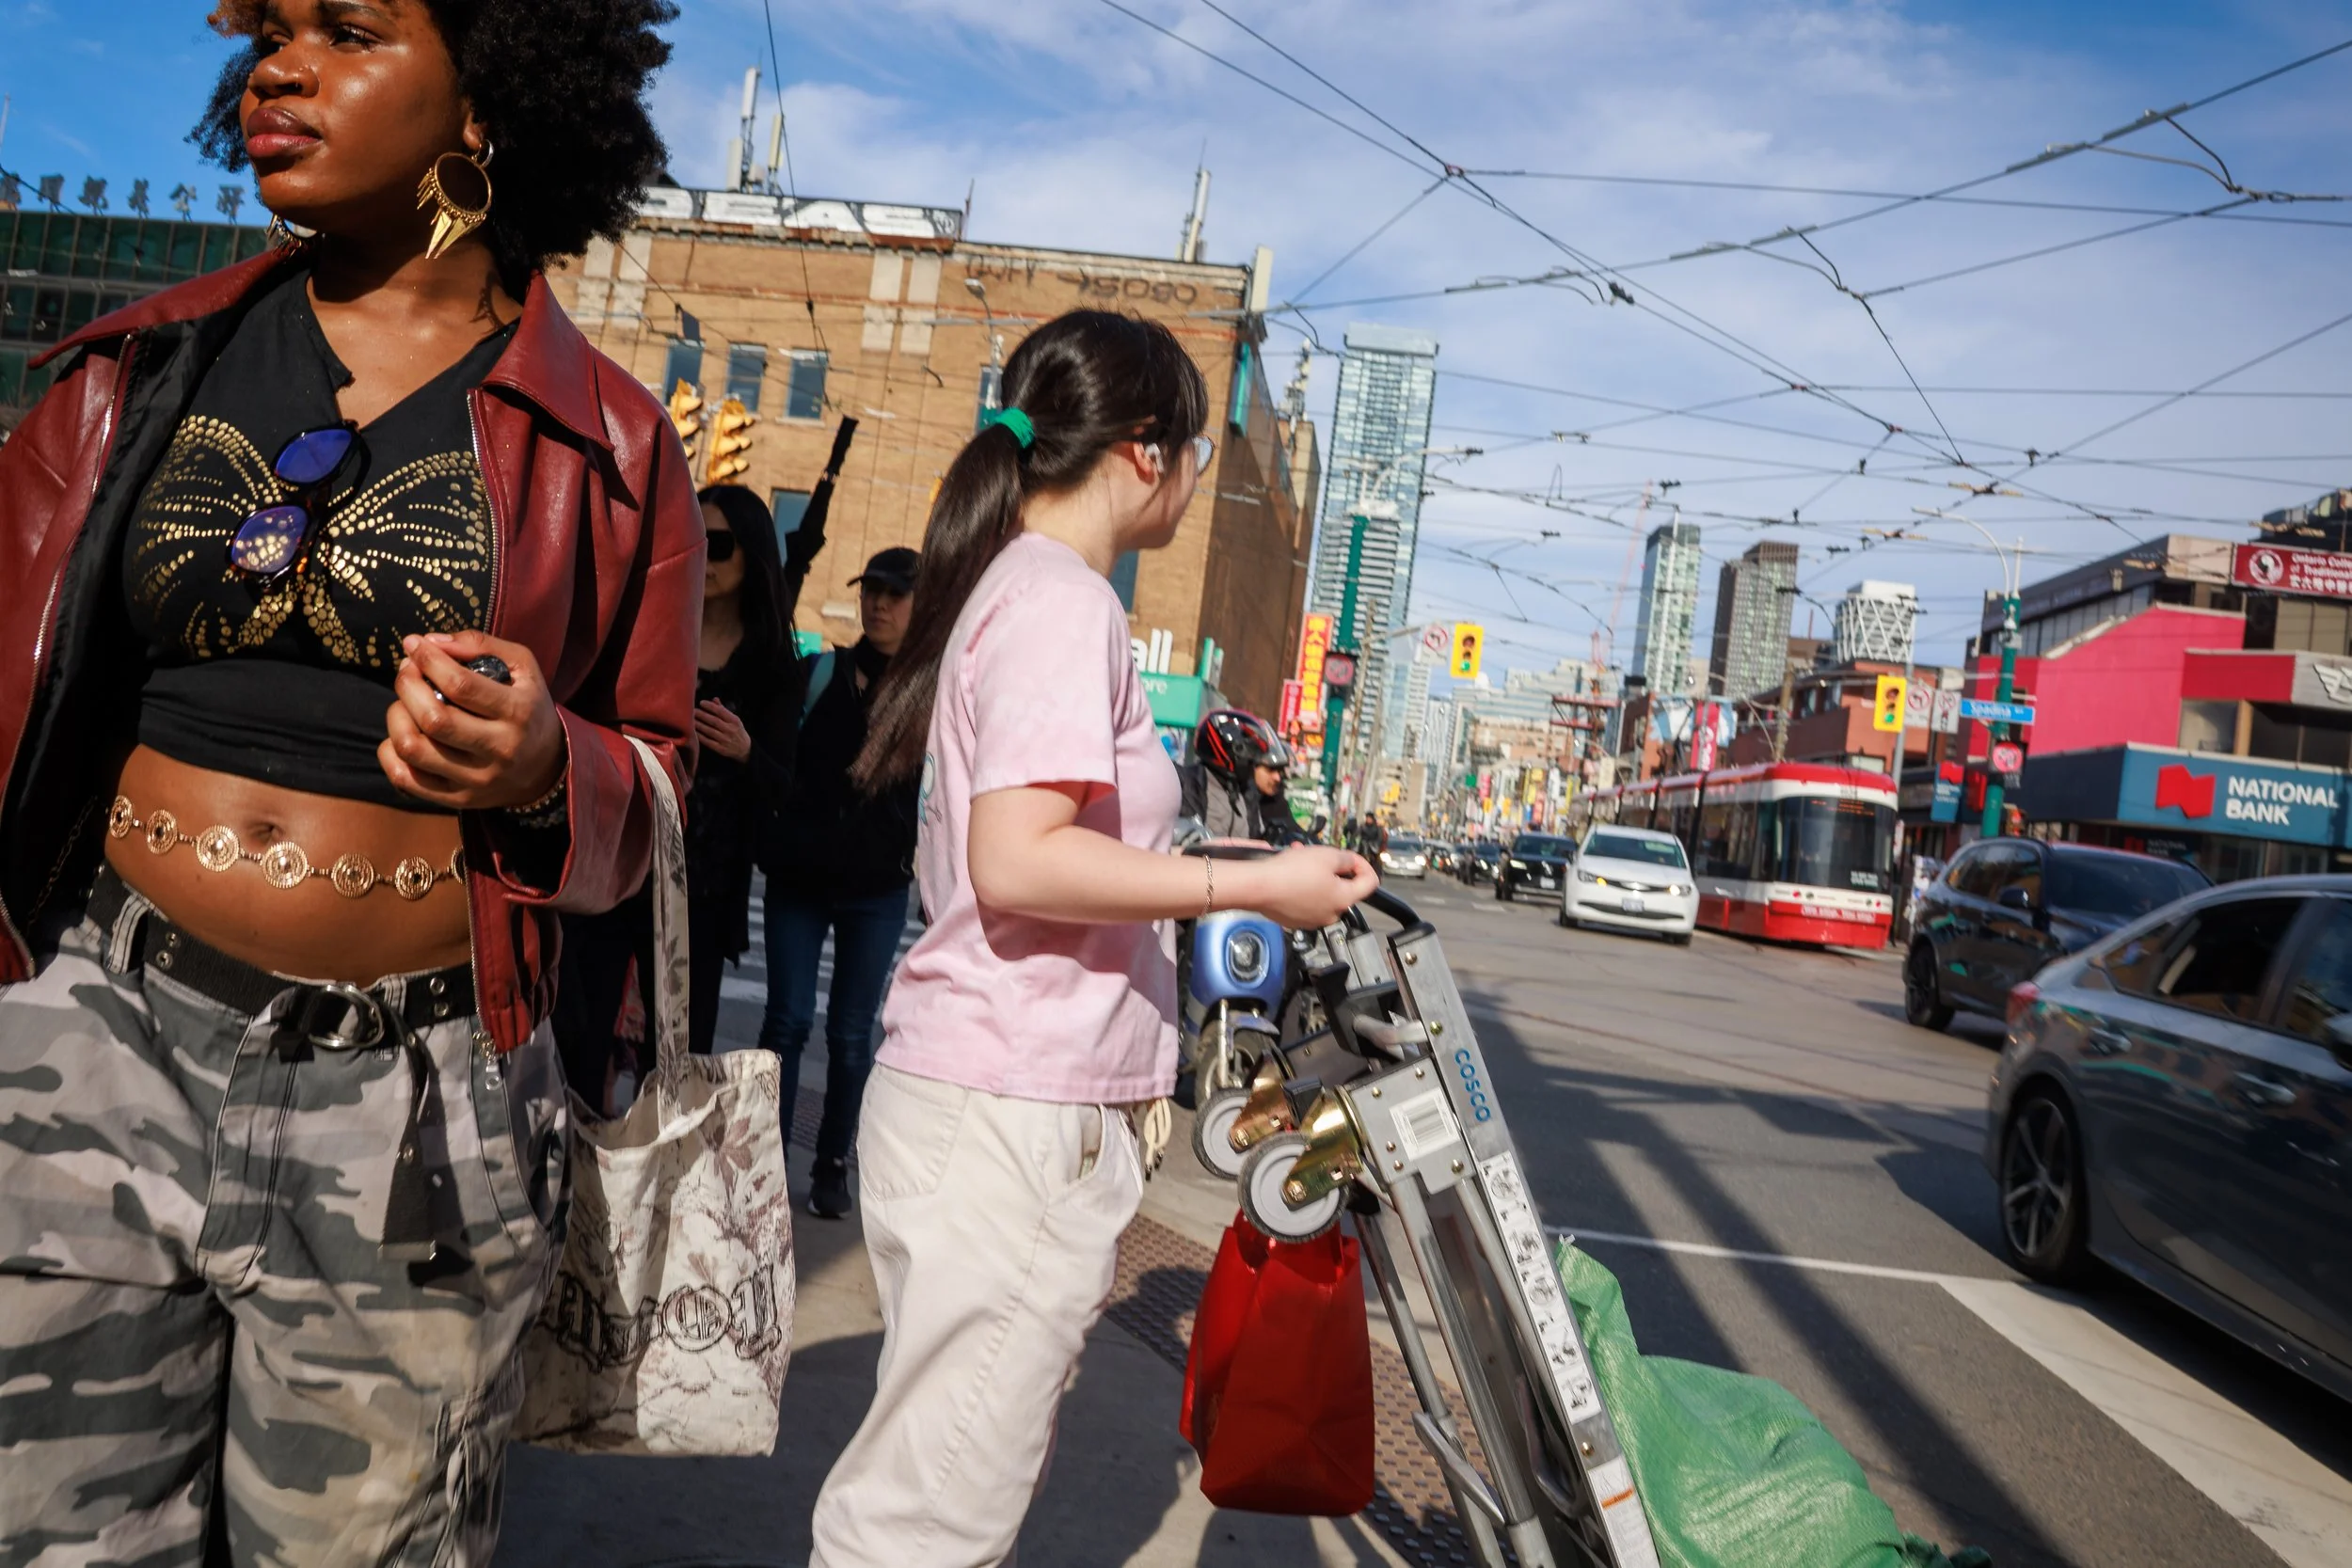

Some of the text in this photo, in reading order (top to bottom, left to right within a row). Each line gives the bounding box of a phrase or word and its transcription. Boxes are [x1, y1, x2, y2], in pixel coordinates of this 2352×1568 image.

[2228, 775, 2340, 809] NATIONAL
[2226, 798, 2290, 827] BANK
[1454, 1048, 1491, 1123] COSCO
